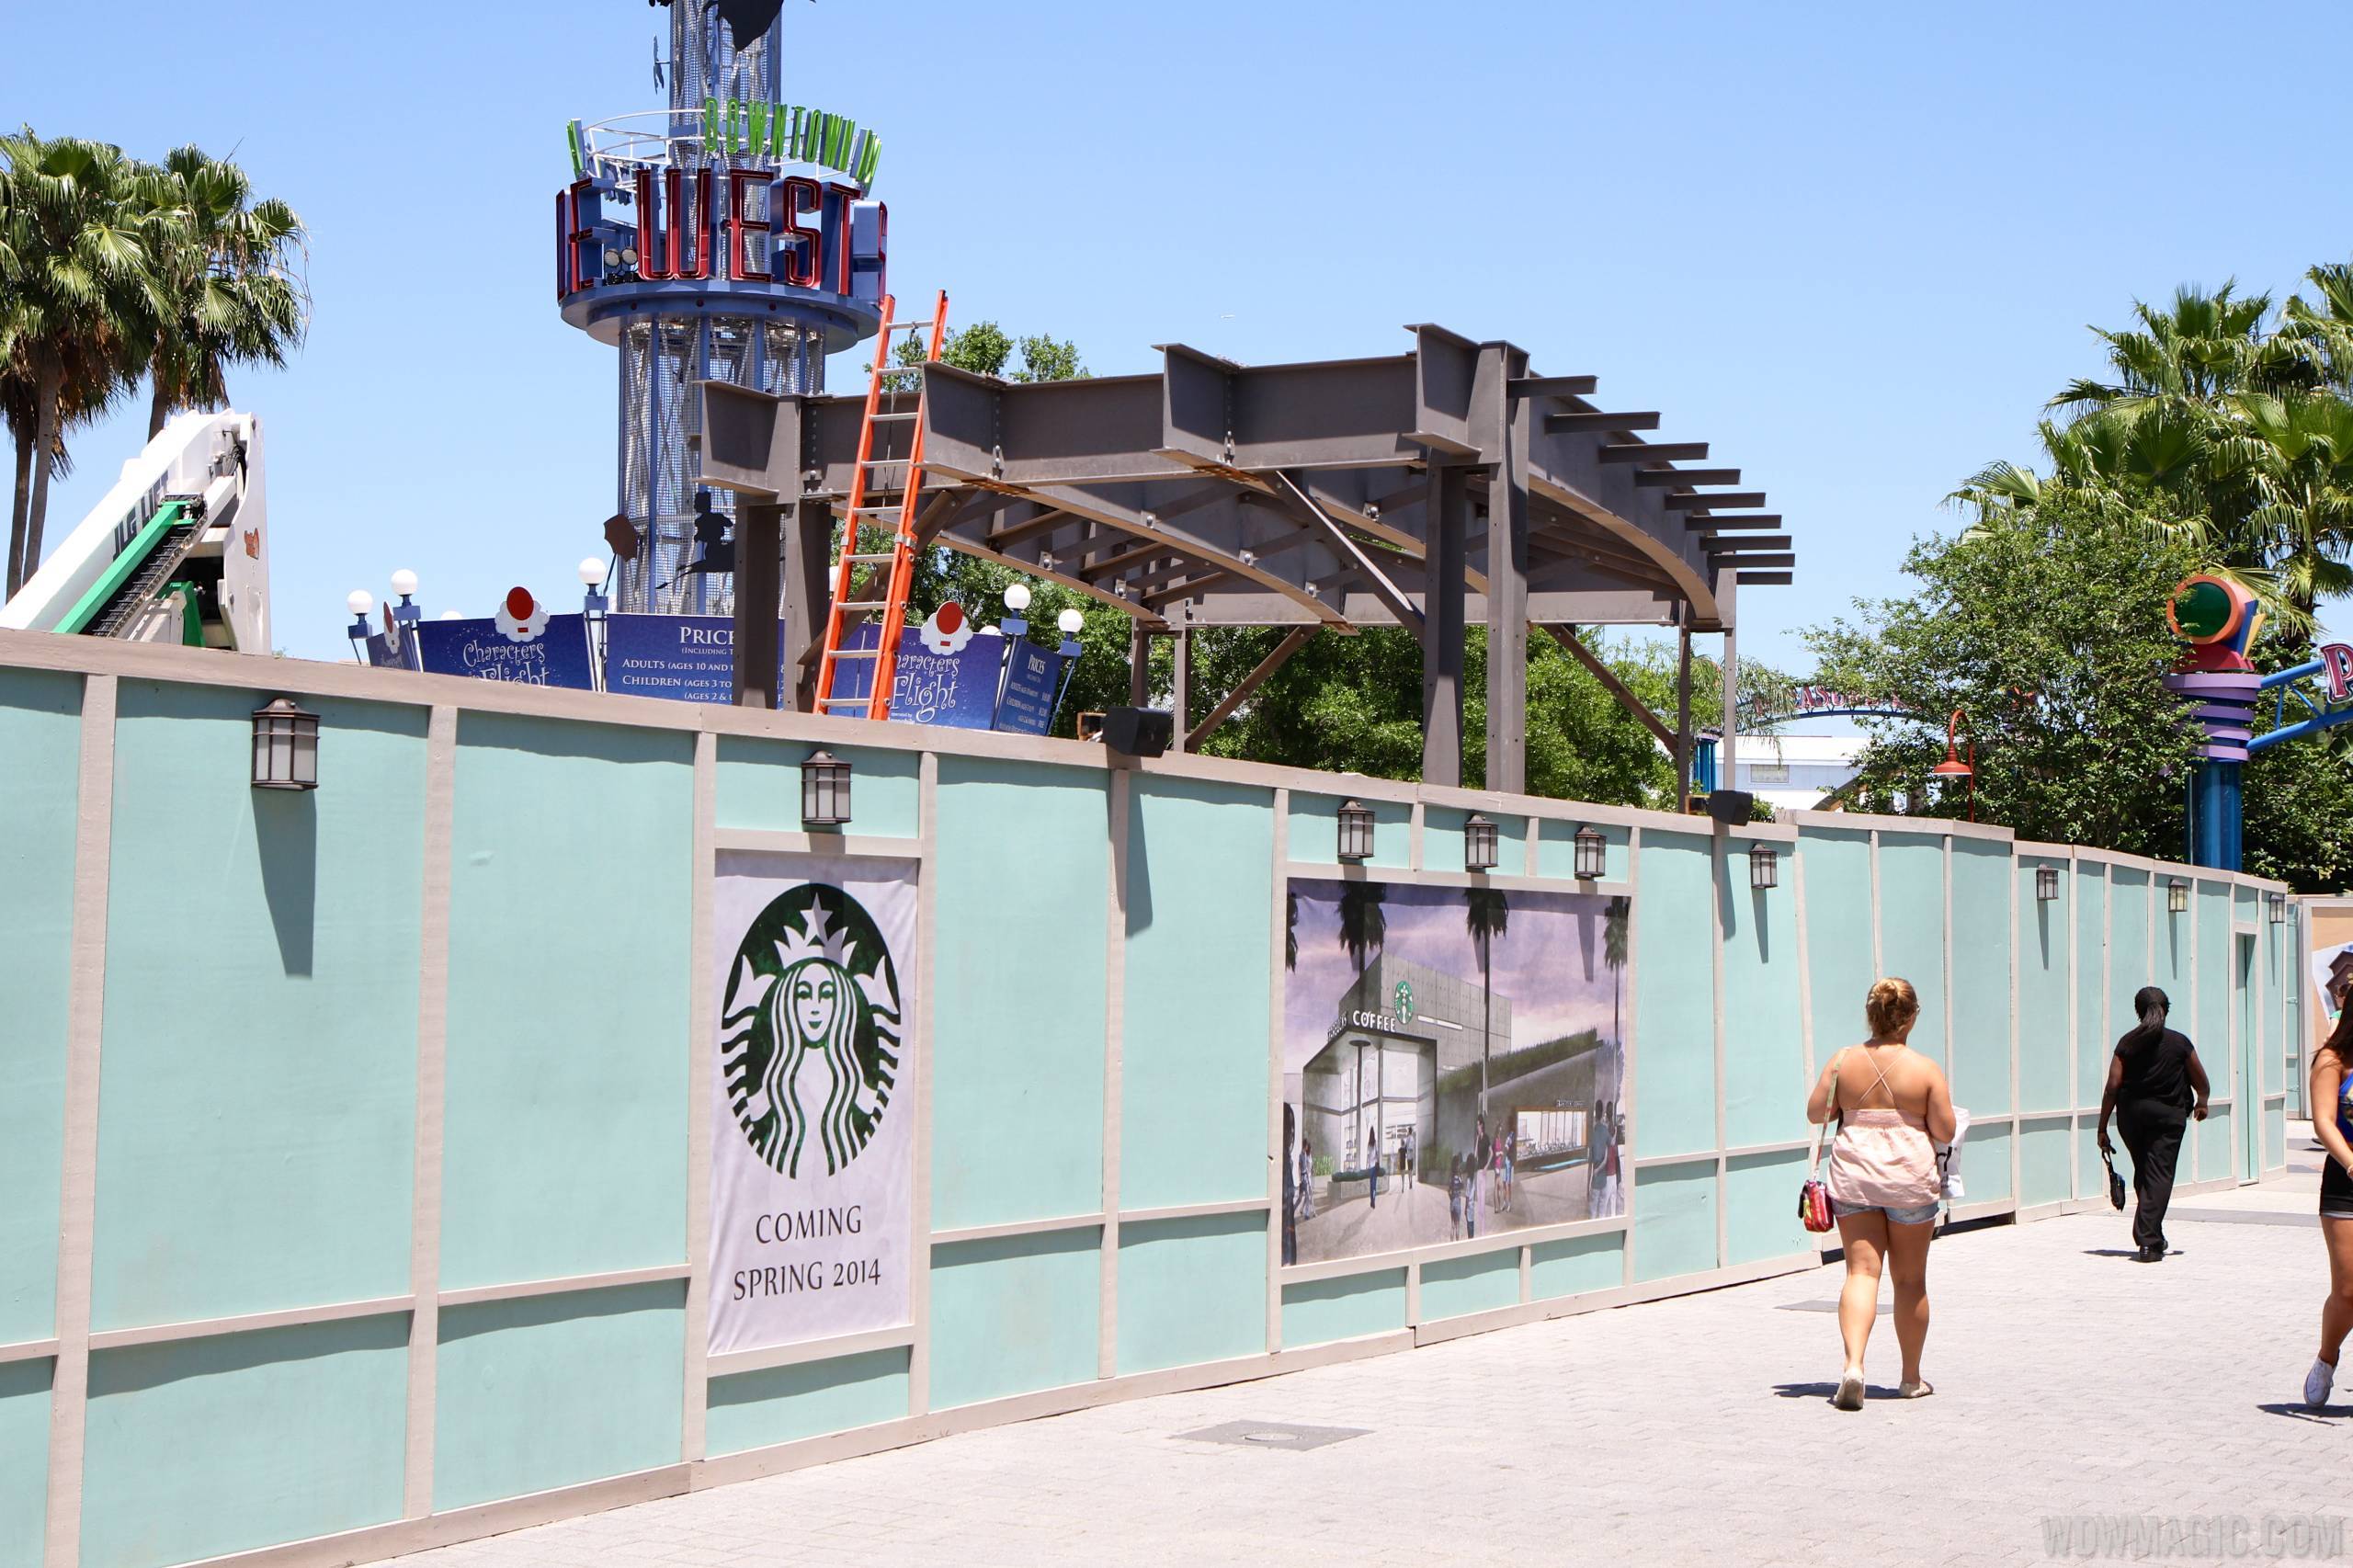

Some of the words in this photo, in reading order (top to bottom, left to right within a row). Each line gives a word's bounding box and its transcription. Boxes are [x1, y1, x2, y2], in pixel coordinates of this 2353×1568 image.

[705, 97, 856, 172] DOWNTOWN
[636, 168, 861, 296] WEST
[679, 626, 734, 645] PRIC
[462, 640, 546, 667] Characters
[622, 659, 665, 669] ADULTS
[697, 663, 707, 671] 10
[897, 653, 961, 677] aracters
[622, 676, 681, 687] CHILDREN
[890, 672, 959, 723] Flight
[1352, 1009, 1396, 1032] COFFEE
[756, 1205, 861, 1244] COMING
[733, 1261, 823, 1301] SPRING
[833, 1258, 881, 1287] 2014
